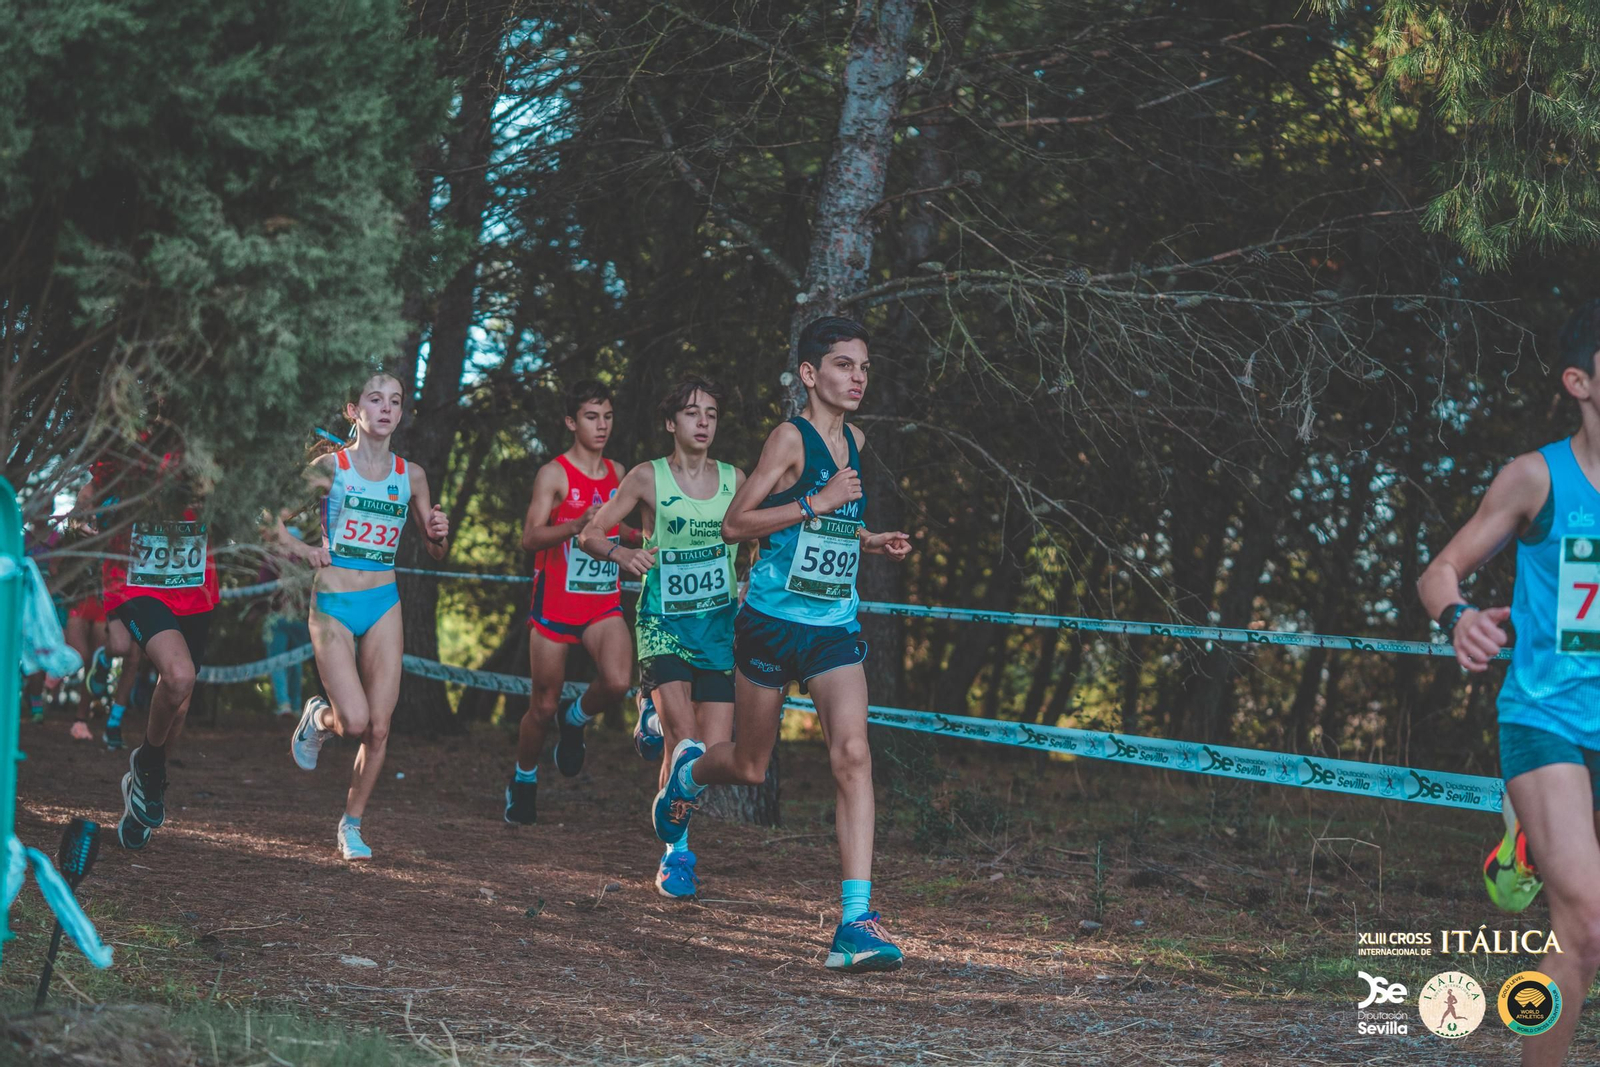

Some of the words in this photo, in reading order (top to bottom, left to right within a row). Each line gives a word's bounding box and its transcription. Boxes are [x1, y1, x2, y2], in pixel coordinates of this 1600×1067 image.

[343, 519, 400, 547] 5232
[138, 546, 202, 569] 7950
[801, 546, 857, 577] 5892
[575, 558, 618, 577] 7940
[668, 568, 725, 595] 8043
[1048, 738, 1077, 750] Sevilla
[1139, 750, 1169, 763] Sevilla
[1235, 764, 1267, 777] Sevilla
[1337, 777, 1370, 790] Sevilla
[1446, 790, 1481, 805] Sevilla
